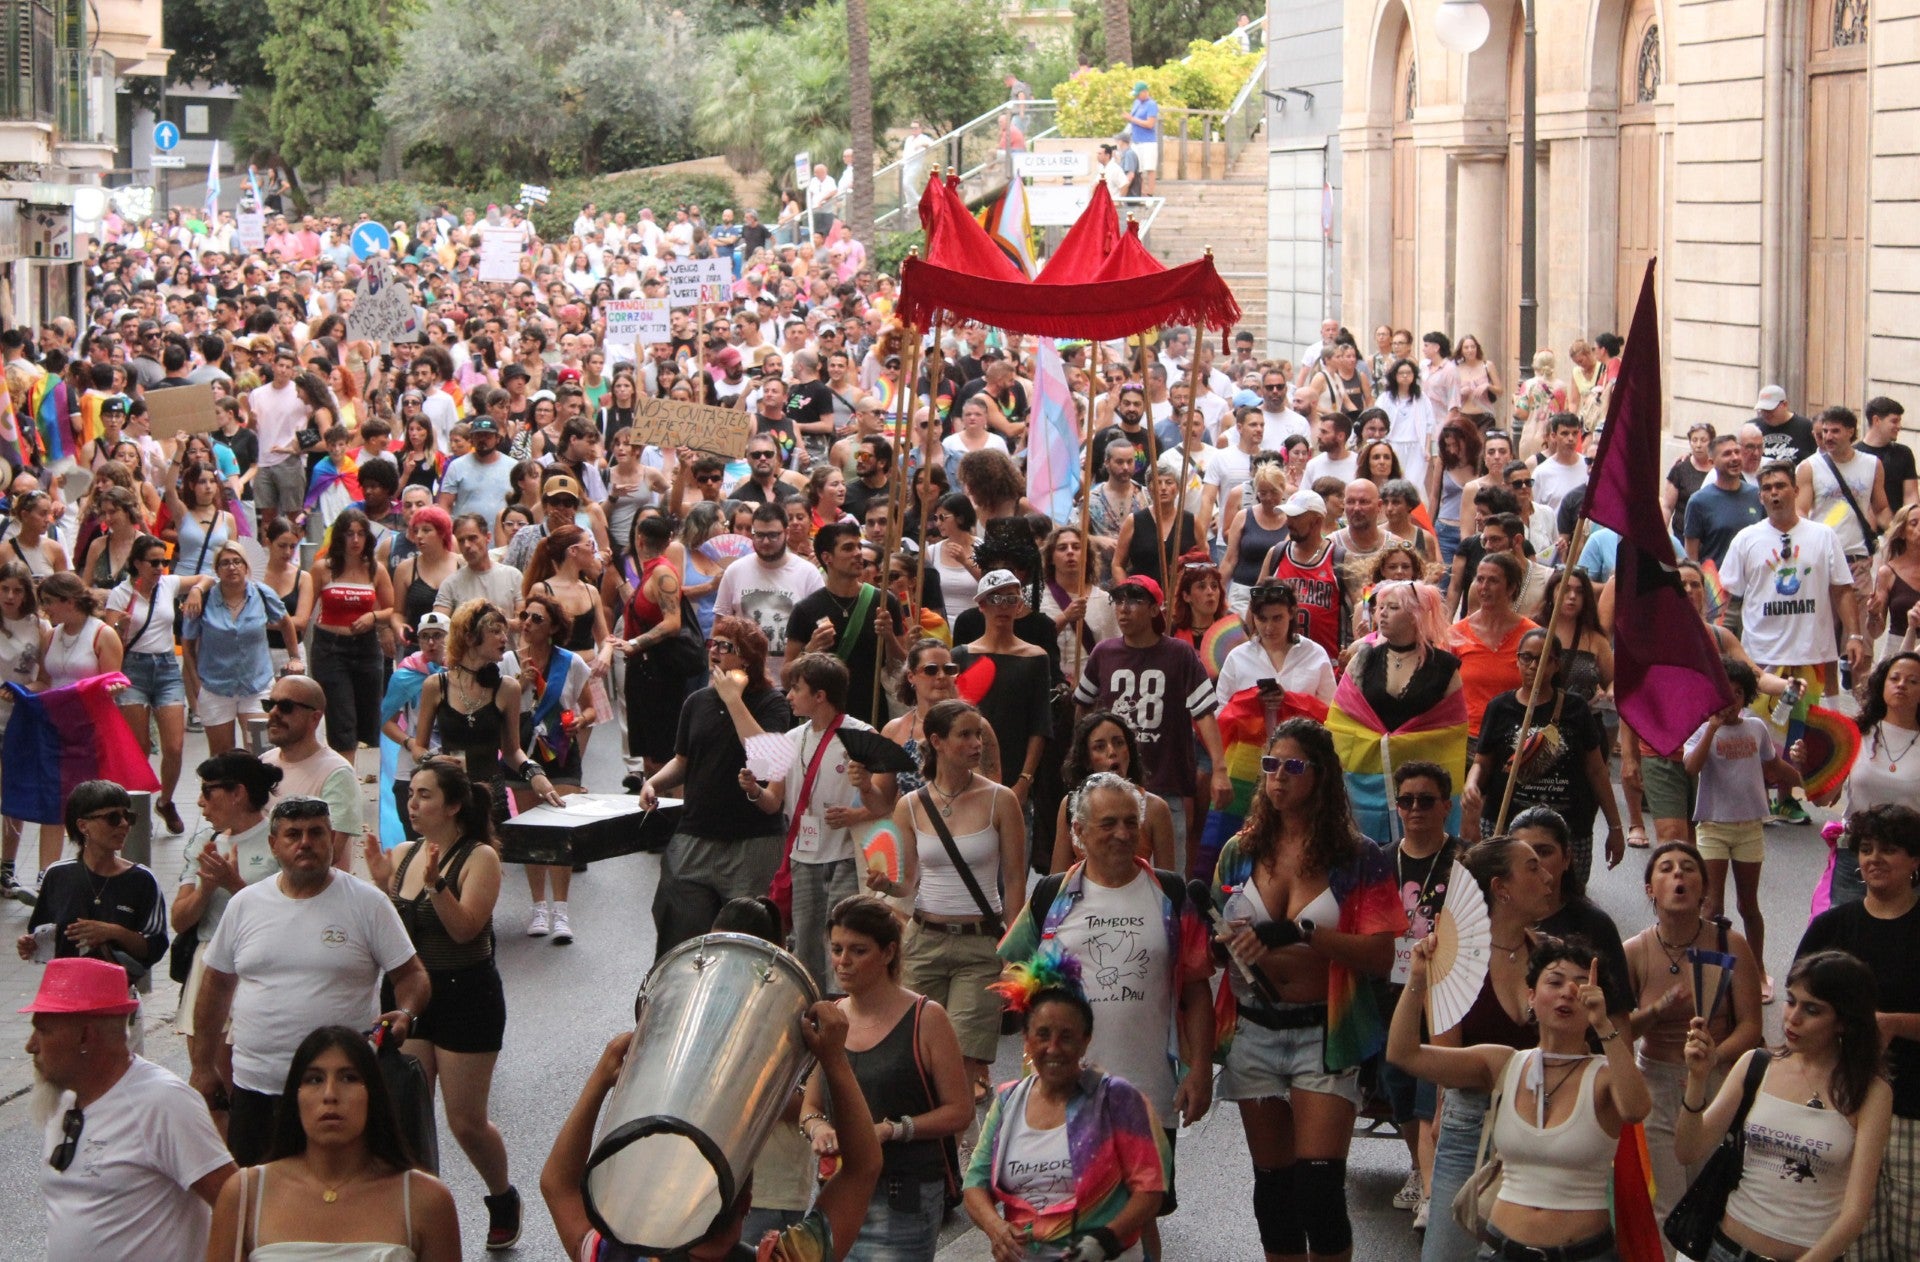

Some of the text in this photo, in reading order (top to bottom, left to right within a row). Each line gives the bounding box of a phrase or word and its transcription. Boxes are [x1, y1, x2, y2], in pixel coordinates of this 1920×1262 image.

[669, 263, 716, 273] VENGO A
[673, 288, 698, 298] VERTE
[635, 398, 751, 430] NOS QUITASTEIS
[633, 419, 650, 429] LA
[657, 419, 698, 434] FIESTA
[645, 429, 671, 445] LA
[1763, 599, 1815, 616] HUMAN
[1110, 669, 1166, 728] 28
[1135, 731, 1161, 743] KEY
[802, 826, 818, 835] VOL
[1085, 915, 1145, 929] TAMBORS
[1396, 950, 1412, 960] VO
[1745, 1122, 1833, 1152] ERYONE GET
[1745, 1132, 1822, 1158] ISEXUAL
[1008, 1159, 1073, 1177] TAMBOR
